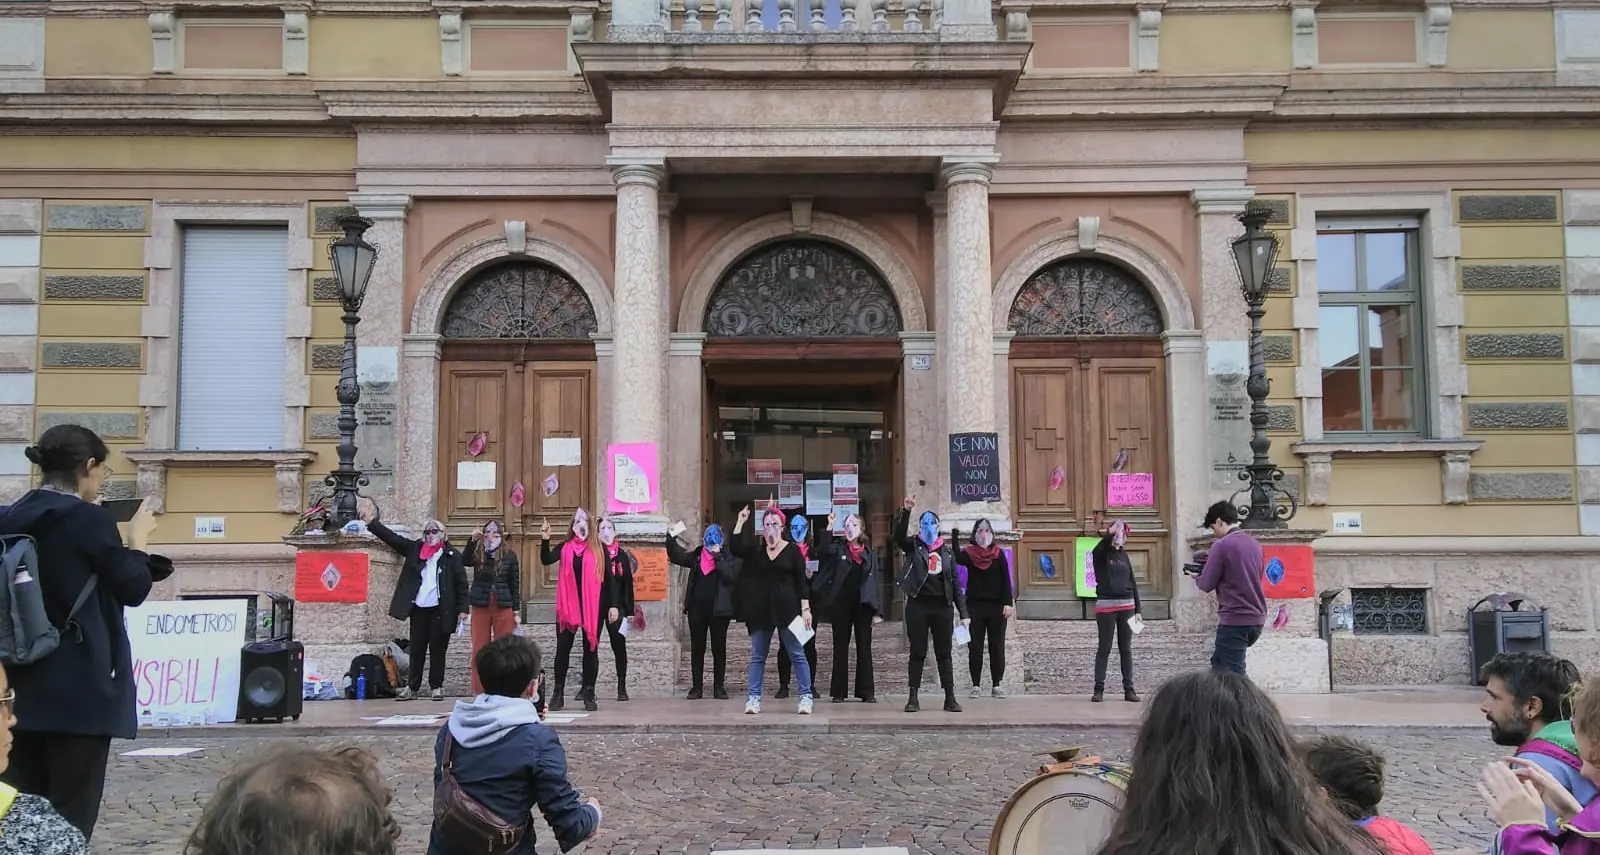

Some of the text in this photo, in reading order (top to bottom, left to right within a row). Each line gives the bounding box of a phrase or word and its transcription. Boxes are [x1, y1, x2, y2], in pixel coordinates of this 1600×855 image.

[953, 436, 996, 452] SE NON
[958, 454, 990, 468] VALGO
[965, 469, 987, 480] NON
[955, 483, 998, 496] PRODUCO
[1127, 492, 1149, 501] LUSSO
[146, 612, 238, 635] ENDOMETRIOSI
